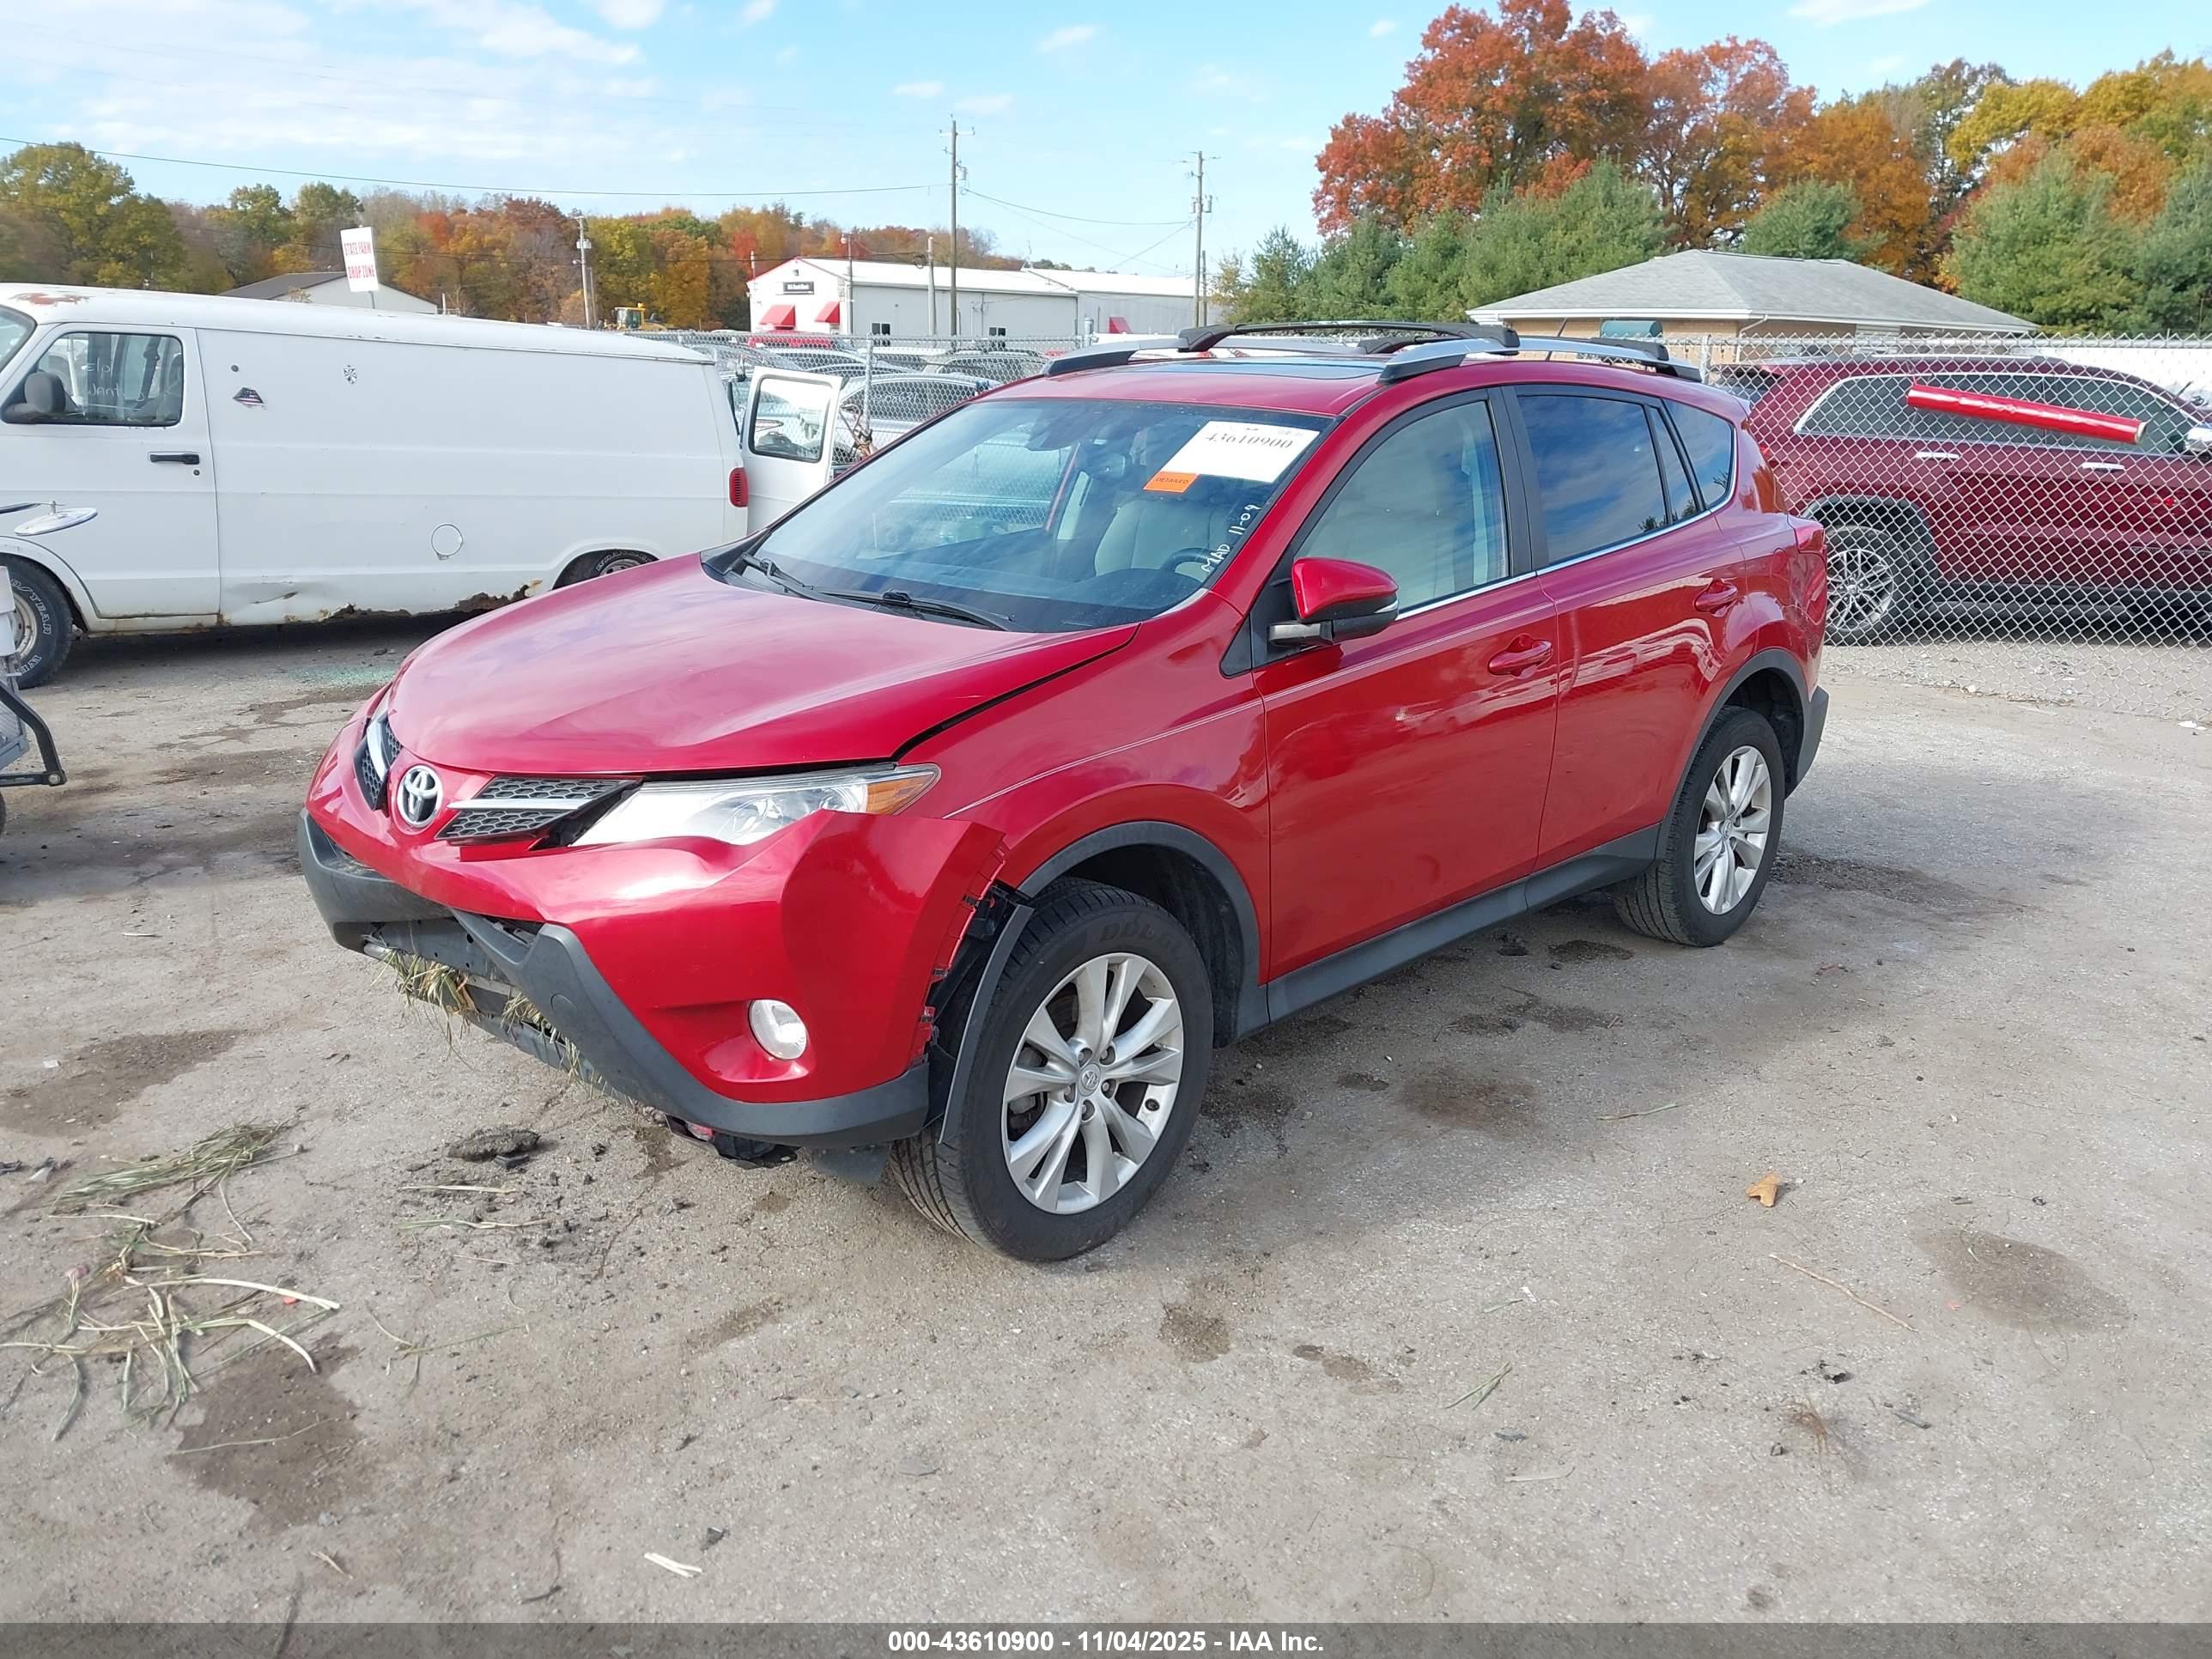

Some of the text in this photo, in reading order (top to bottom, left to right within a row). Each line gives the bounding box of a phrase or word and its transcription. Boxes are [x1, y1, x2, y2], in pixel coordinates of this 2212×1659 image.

[344, 241, 372, 256] STATE FARM
[348, 264, 375, 279] DROP ZONE
[1205, 432, 1294, 449] 43610900
